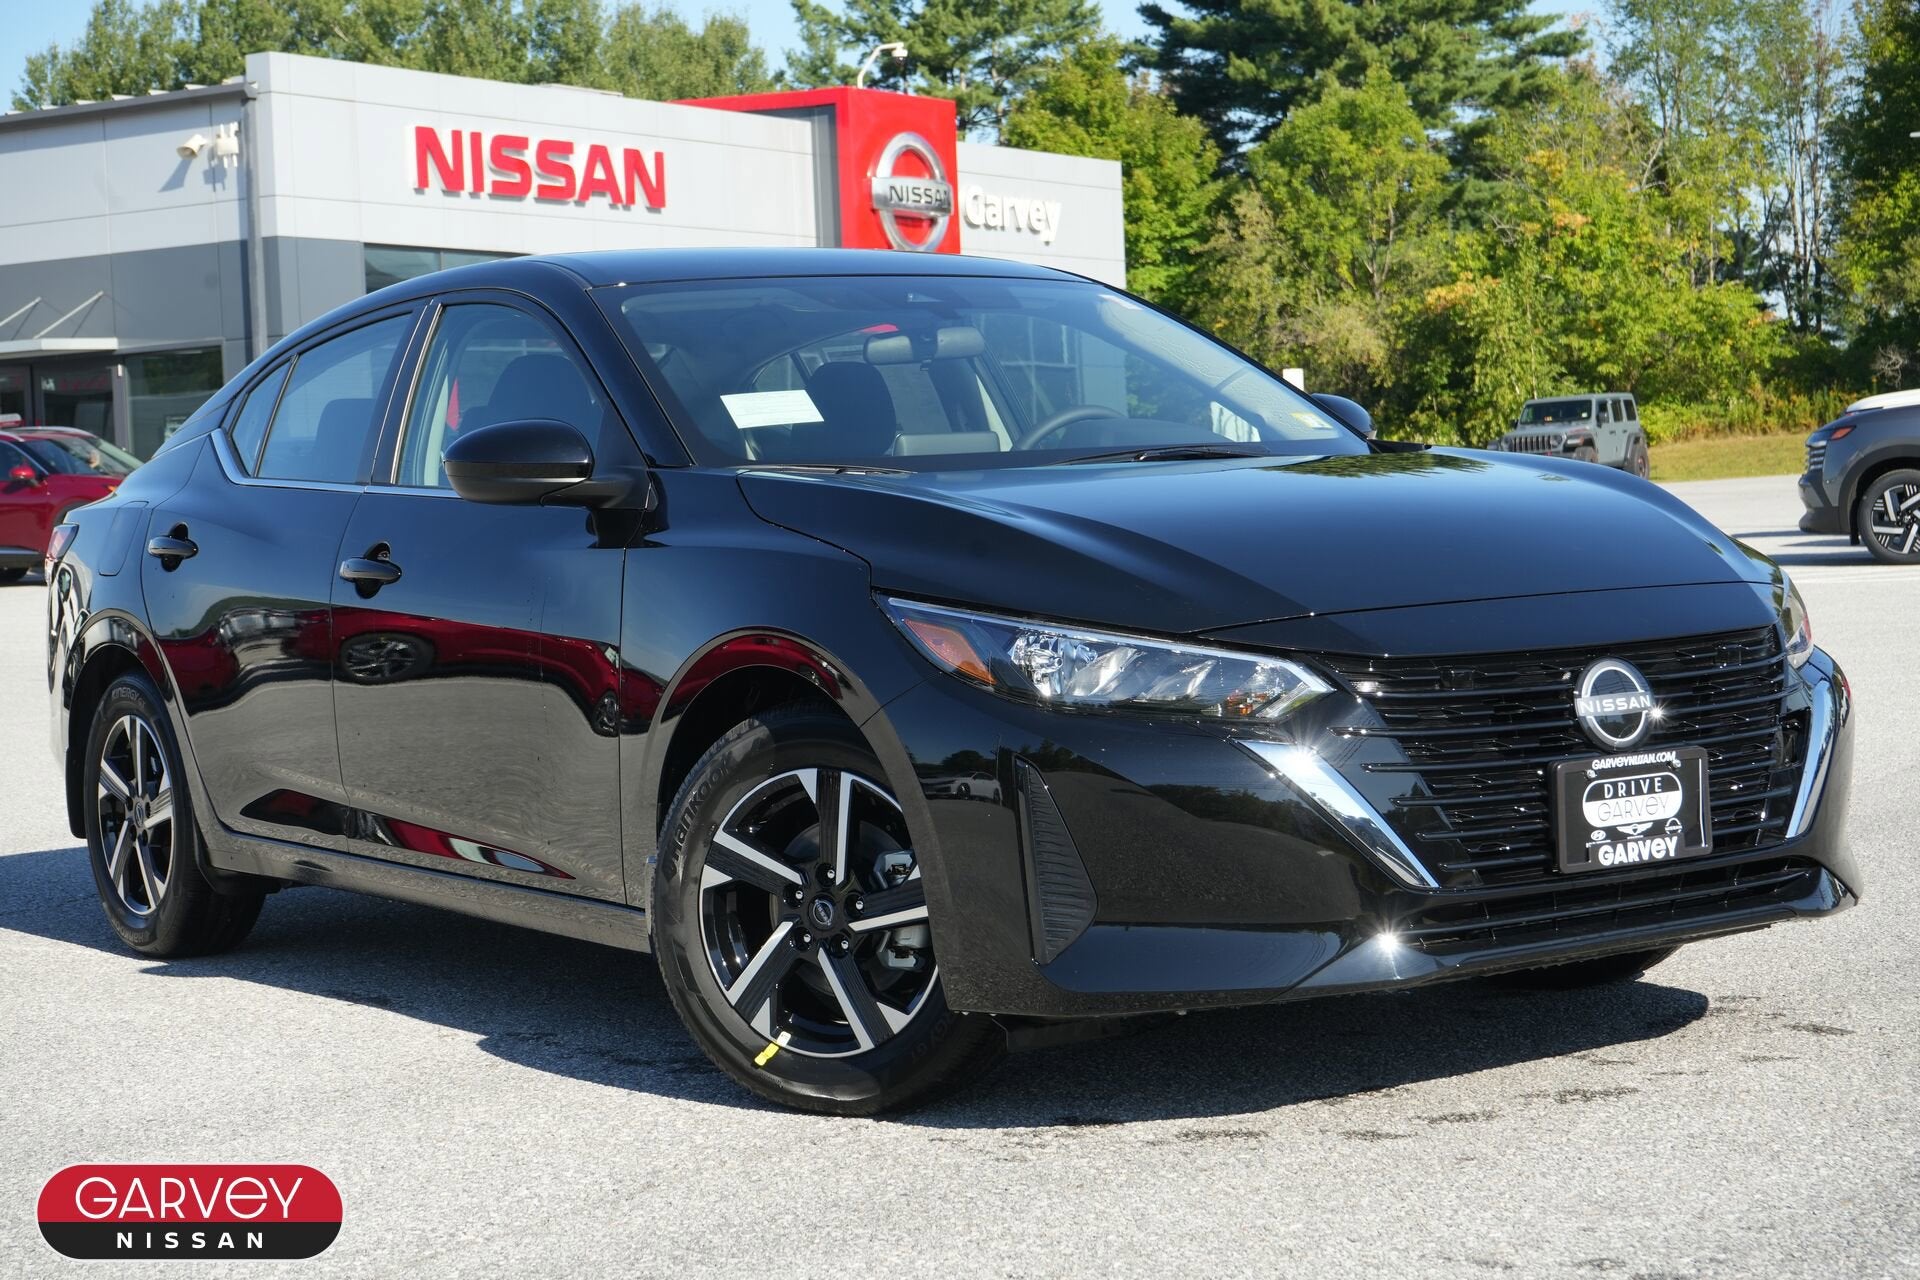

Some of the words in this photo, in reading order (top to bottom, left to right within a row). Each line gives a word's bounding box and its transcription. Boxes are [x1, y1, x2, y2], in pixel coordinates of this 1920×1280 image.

[414, 126, 667, 209] NISSAN
[888, 185, 950, 208] NISSAN
[964, 185, 1062, 243] Garvey
[1580, 694, 1651, 714] NISSAN
[1604, 776, 1663, 798] DRIVE
[1598, 836, 1678, 866] GARVEY
